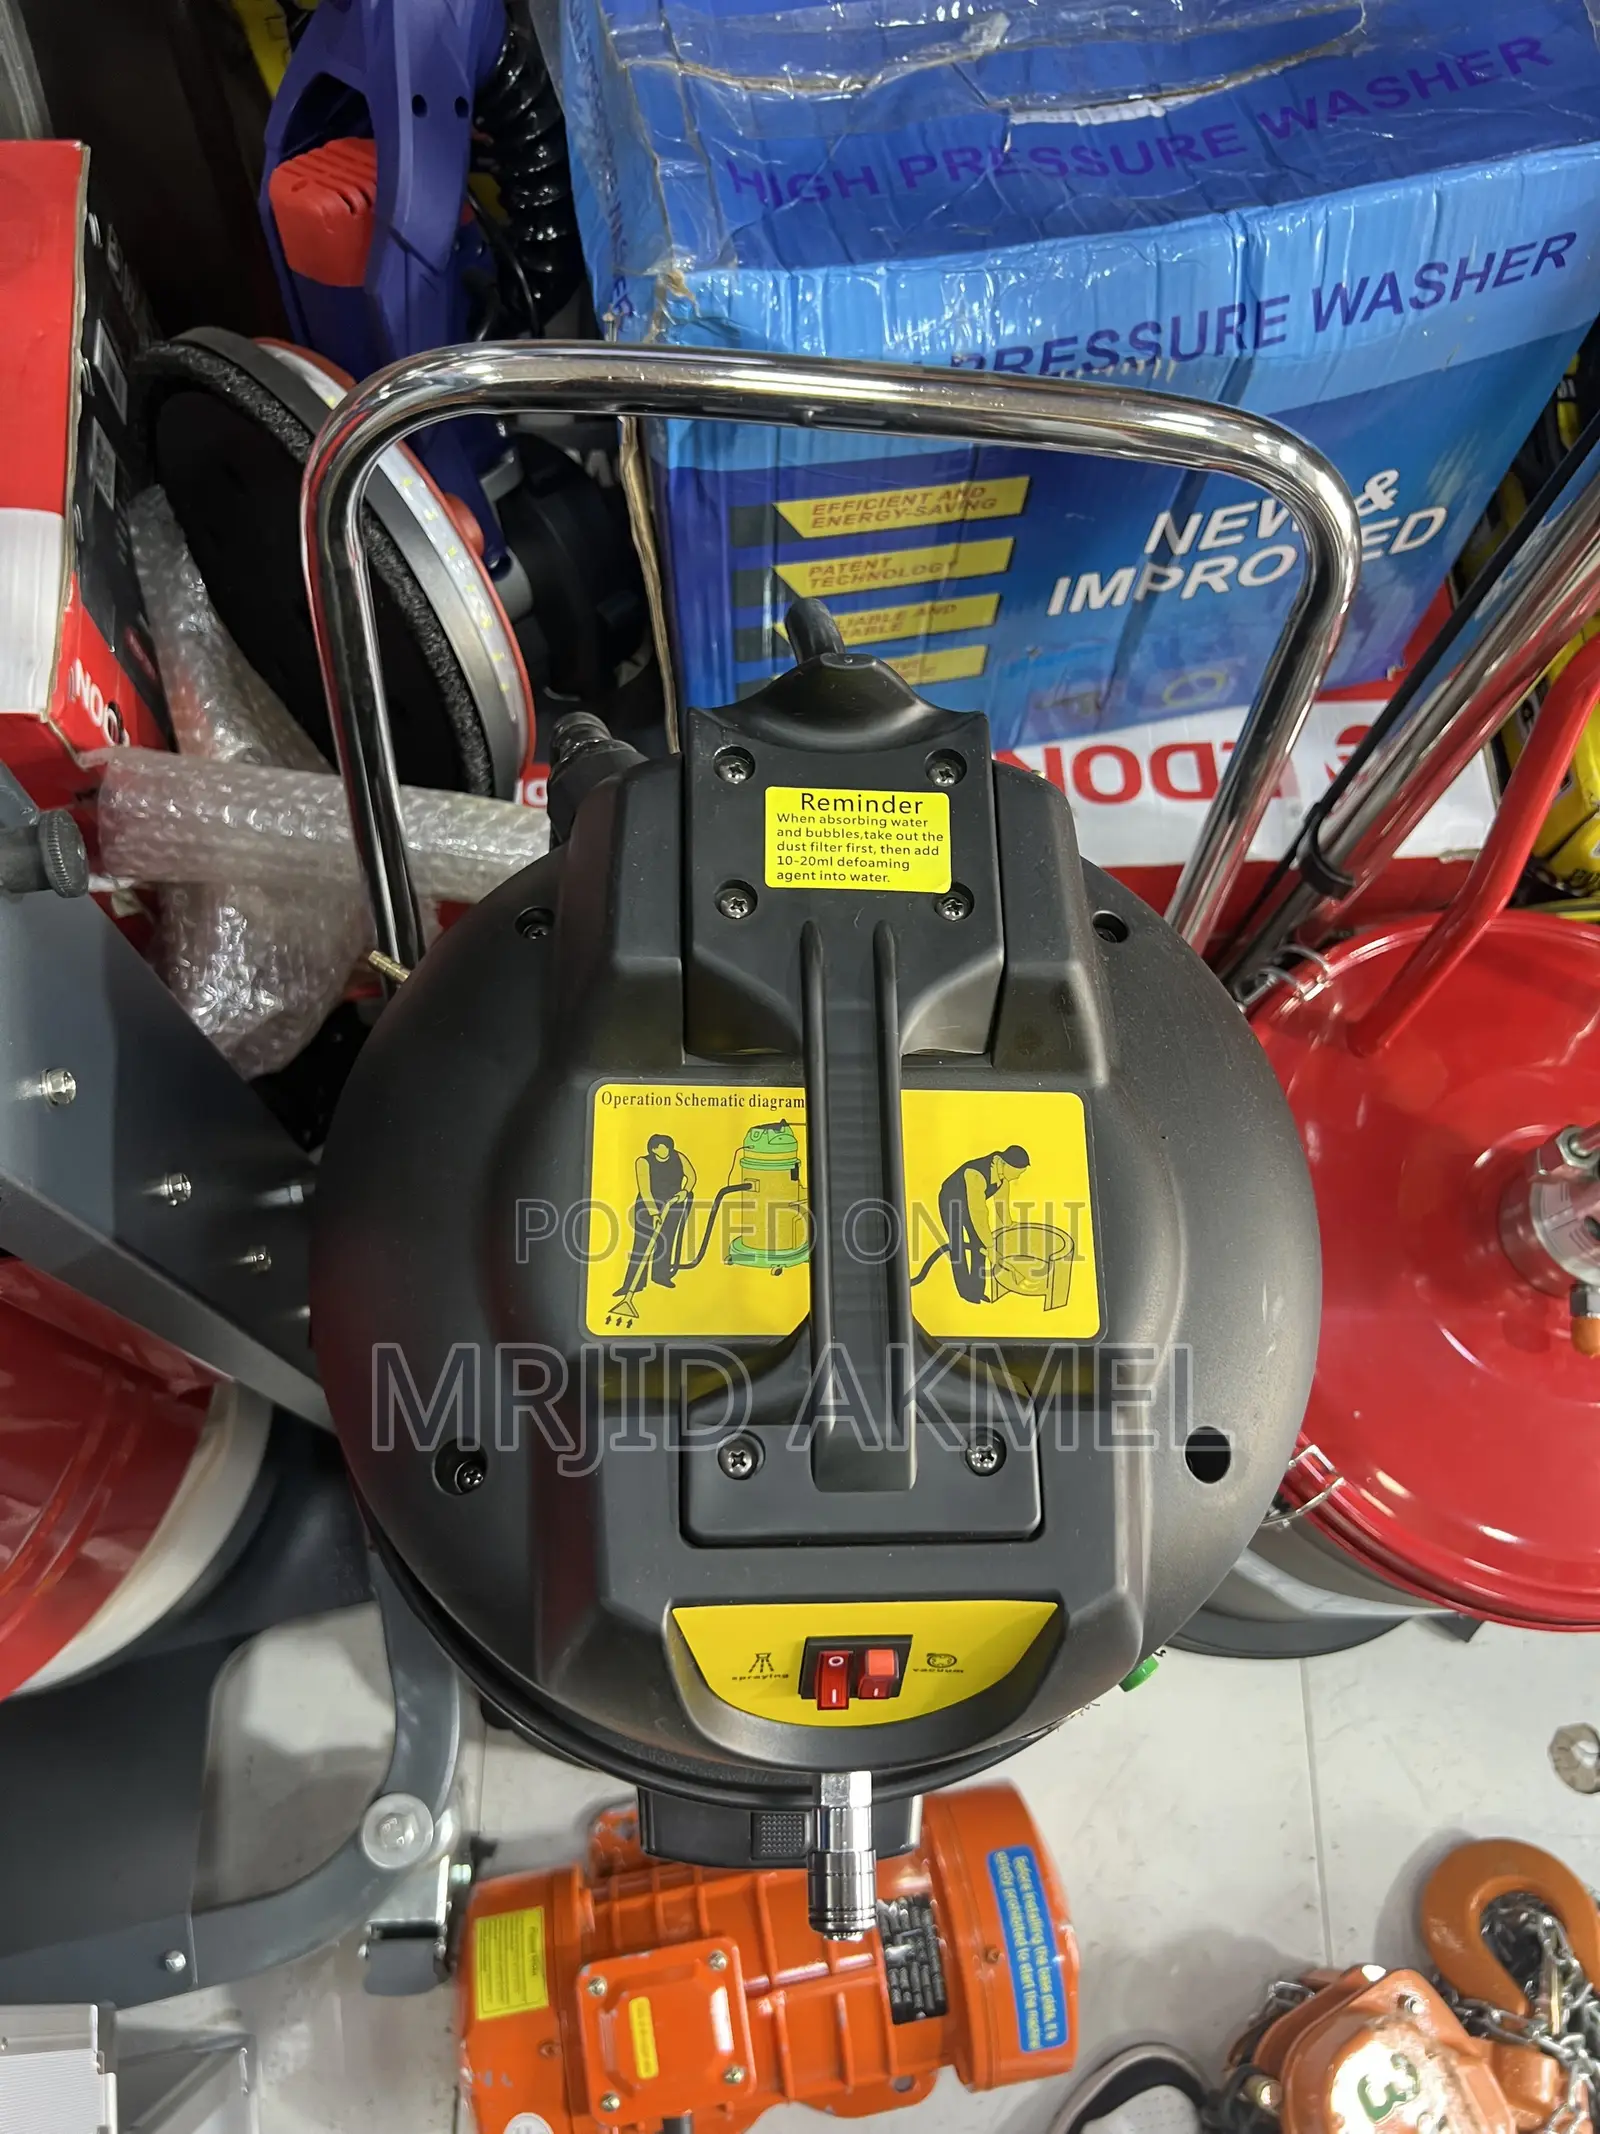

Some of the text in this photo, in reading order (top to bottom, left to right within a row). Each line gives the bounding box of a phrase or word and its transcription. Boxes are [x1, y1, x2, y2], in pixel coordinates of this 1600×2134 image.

[726, 35, 1555, 210] HIGH PRESSURE WASHER
[1312, 231, 1578, 333] WASHER
[811, 498, 998, 529] ENERGY-SAVING
[812, 492, 933, 516] EFFICIENT
[808, 556, 893, 578] PATENT
[1046, 506, 1448, 616] IMPROED
[993, 741, 1288, 805] DON
[801, 792, 924, 815] Reminder
[776, 812, 929, 829] When absorbing water
[776, 827, 802, 838] and
[895, 832, 919, 842] out
[922, 831, 944, 842] the
[776, 841, 940, 856] dust filter first, then add
[776, 855, 911, 872] 10-20ml defoaming
[776, 870, 891, 884] agent into water.
[600, 1090, 806, 1112] Operation Schematic diagram
